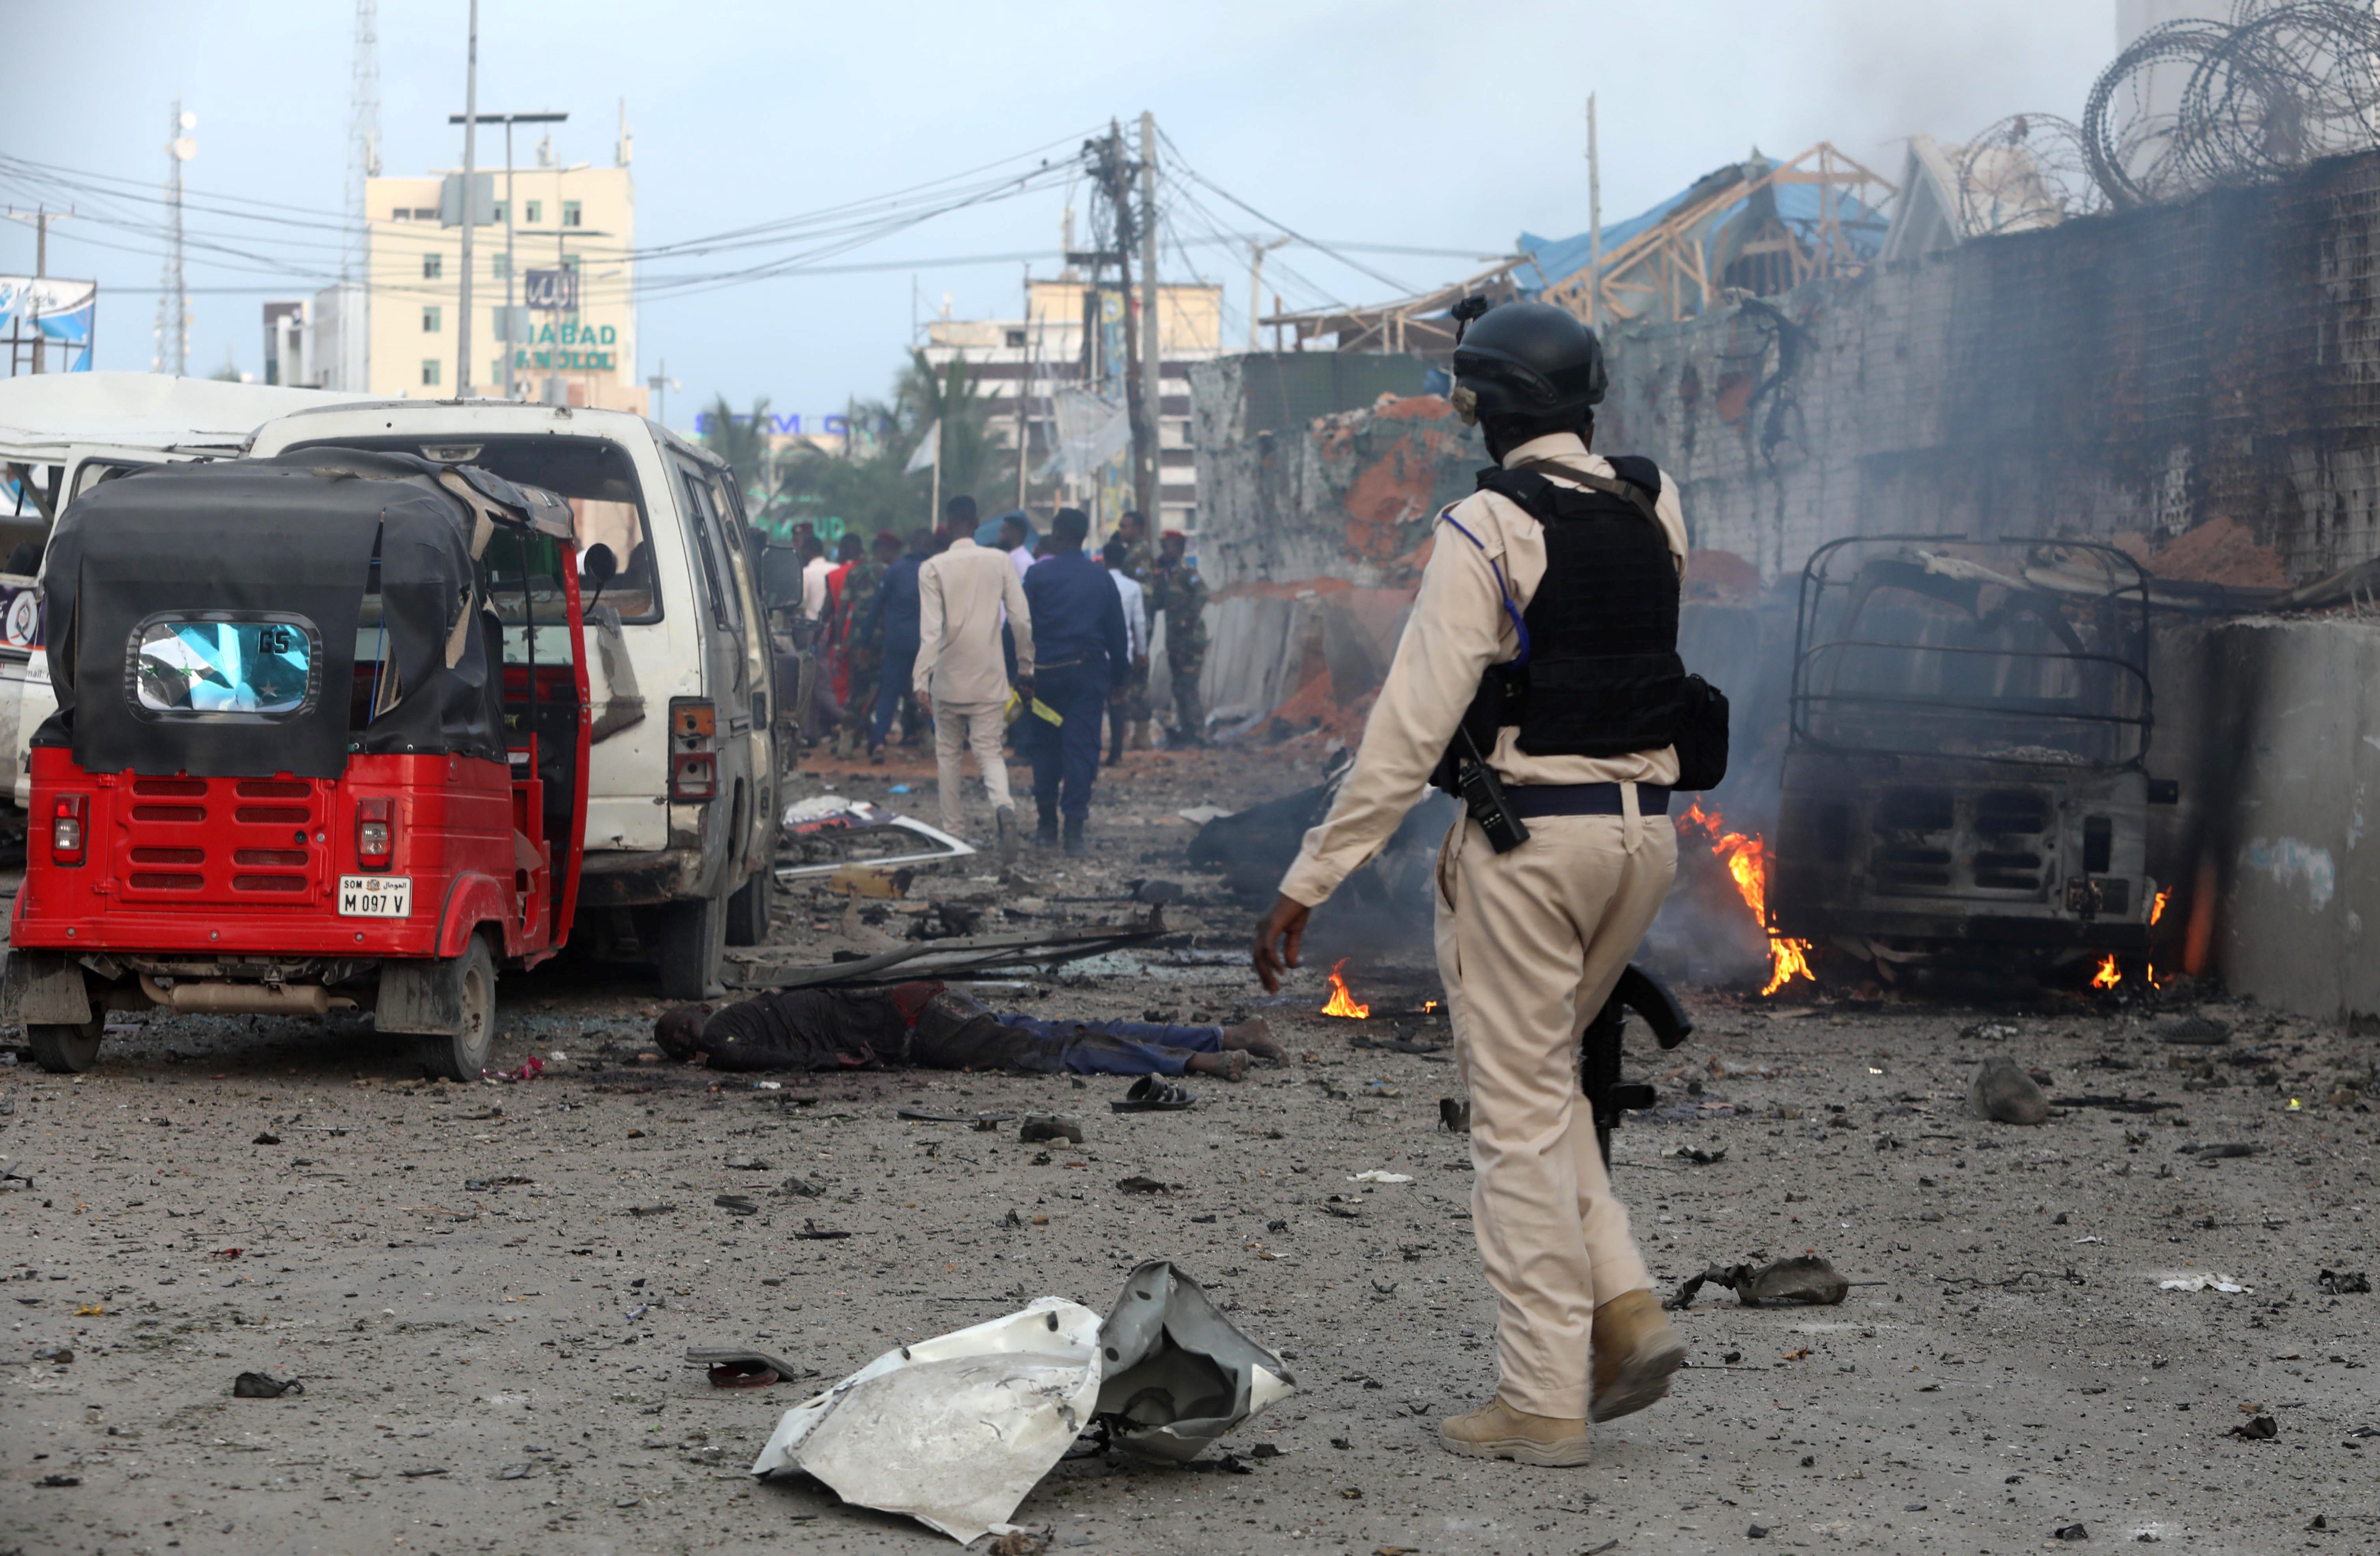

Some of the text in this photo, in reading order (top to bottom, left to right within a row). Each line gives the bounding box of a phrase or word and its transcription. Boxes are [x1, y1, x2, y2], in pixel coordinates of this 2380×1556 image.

[344, 880, 362, 889] SOM
[345, 894, 403, 913] M 097 V
